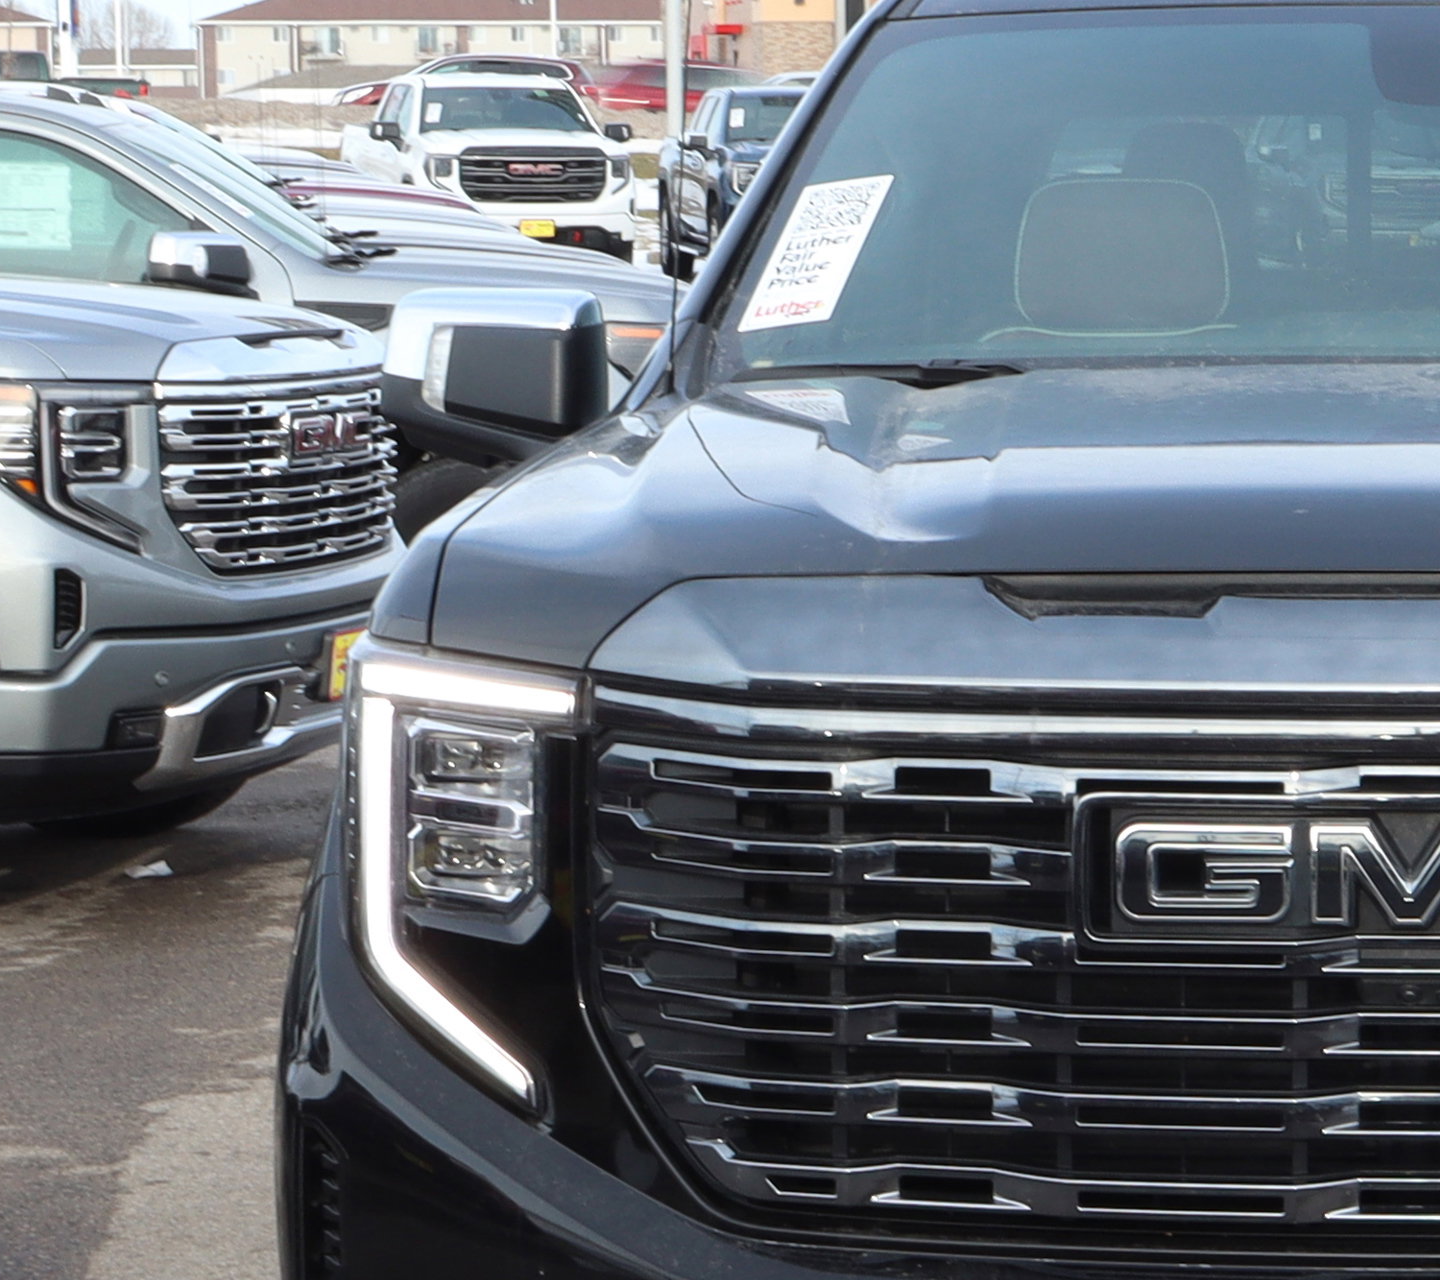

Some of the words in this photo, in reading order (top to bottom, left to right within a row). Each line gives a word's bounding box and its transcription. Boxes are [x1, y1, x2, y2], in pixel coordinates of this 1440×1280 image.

[507, 162, 564, 176] GMC
[785, 234, 854, 252] Luther
[780, 250, 815, 264] Fair
[776, 261, 831, 276] Value
[768, 274, 819, 290] Price
